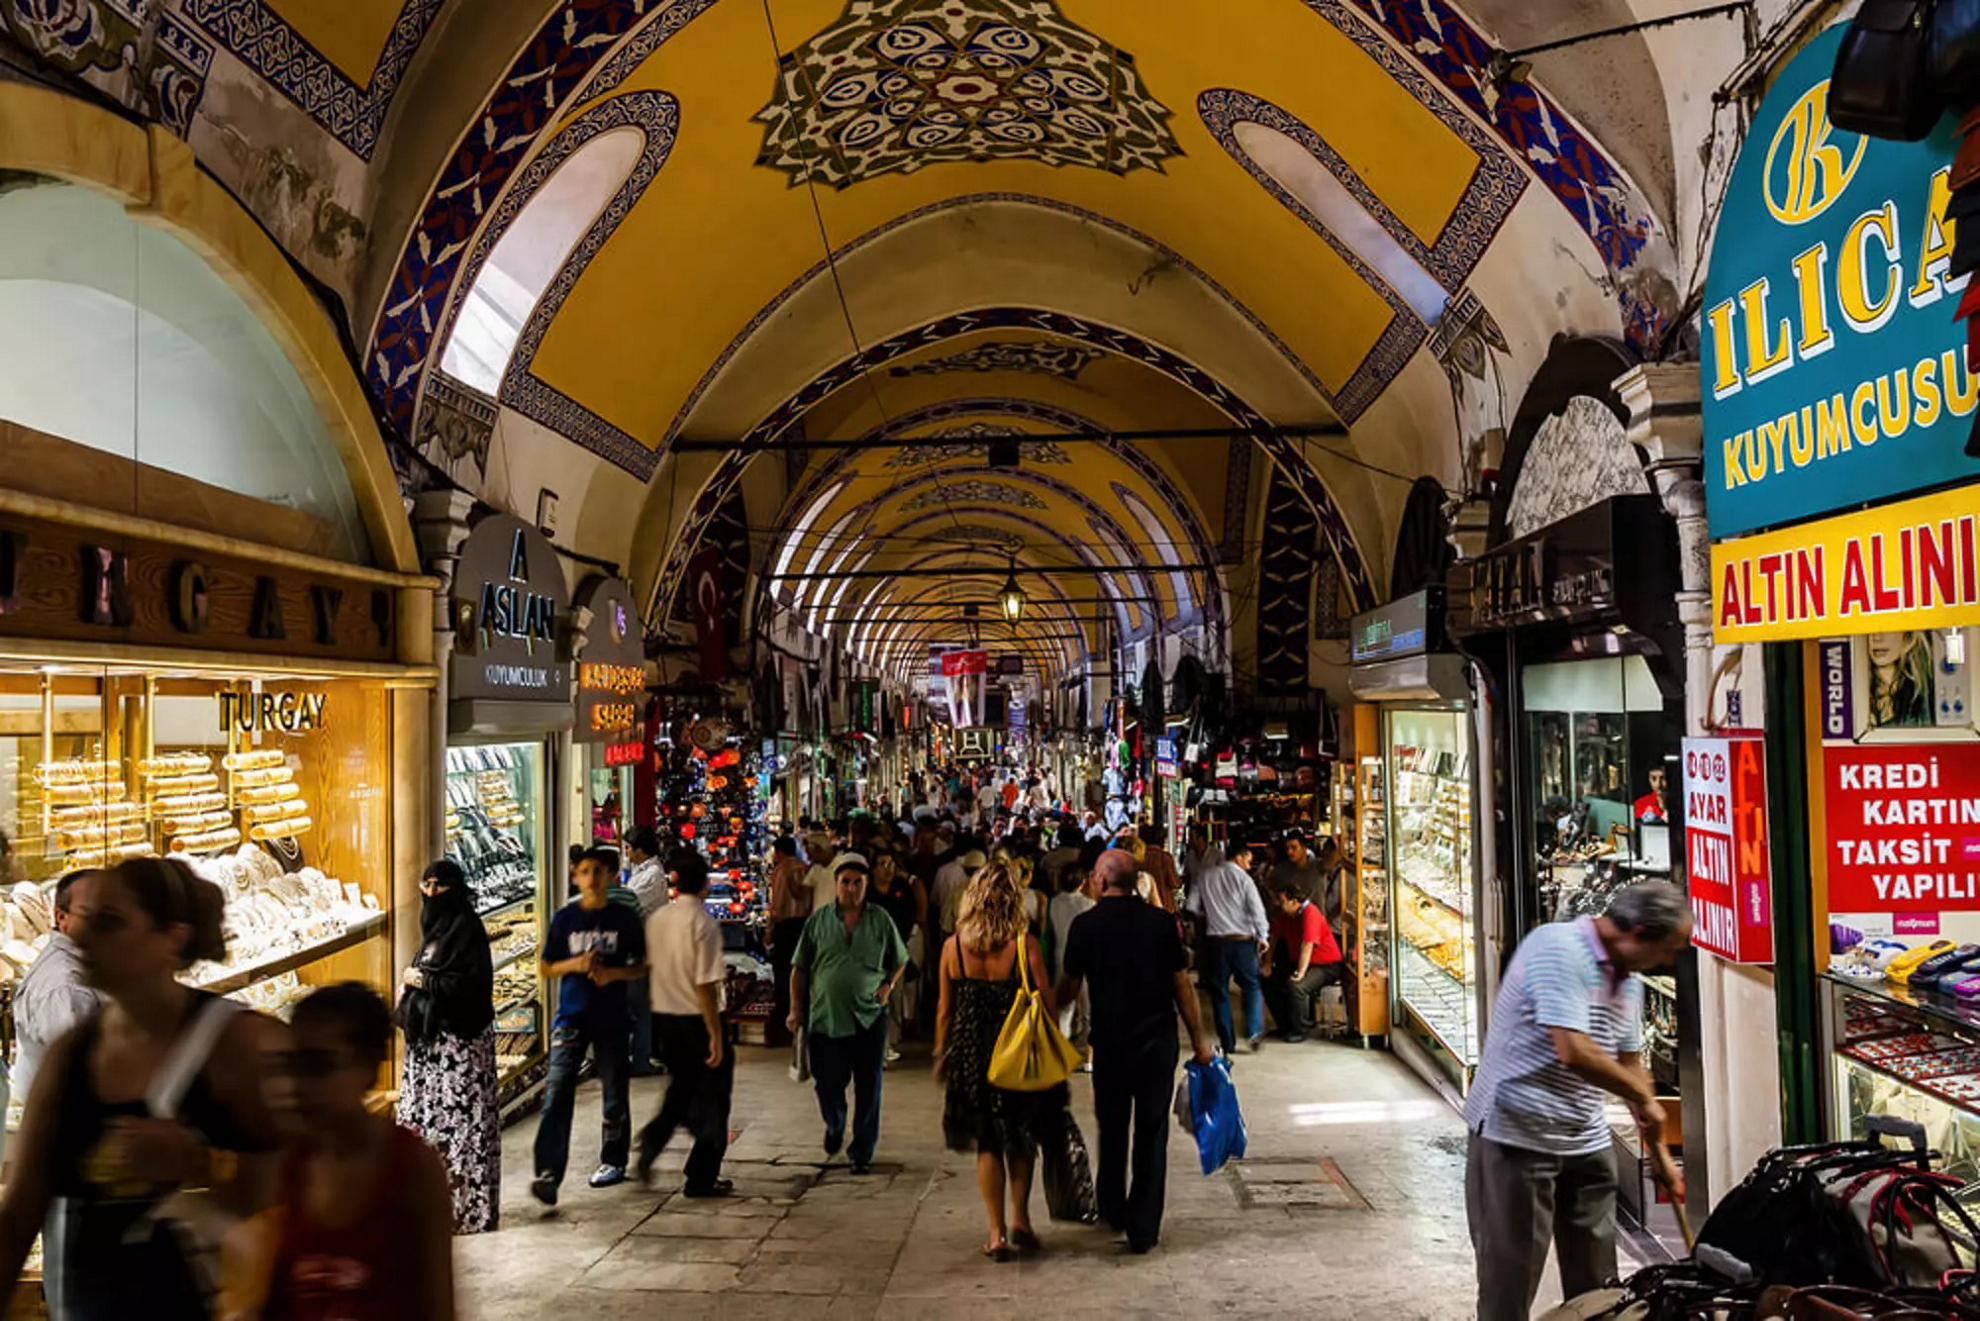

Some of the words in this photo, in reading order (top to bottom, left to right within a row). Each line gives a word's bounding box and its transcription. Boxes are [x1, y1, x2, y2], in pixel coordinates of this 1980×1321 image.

[1722, 343, 1979, 490] KUYUMCUSU
[1719, 545, 1825, 630] ALTIN
[1838, 514, 1980, 616] ALINI
[478, 581, 555, 655] ASLAN
[217, 691, 327, 732] TURGAY
[1826, 645, 1844, 736] WORLD
[1839, 757, 1939, 789] KREDİ
[1689, 791, 1727, 824] AYAR
[1863, 799, 1980, 825] KARTIN
[1692, 833, 1730, 885] ALTIN
[1837, 832, 1951, 865] TAKSİT
[1871, 874, 1978, 900] YAPILI
[1691, 896, 1735, 955] ALINIR
